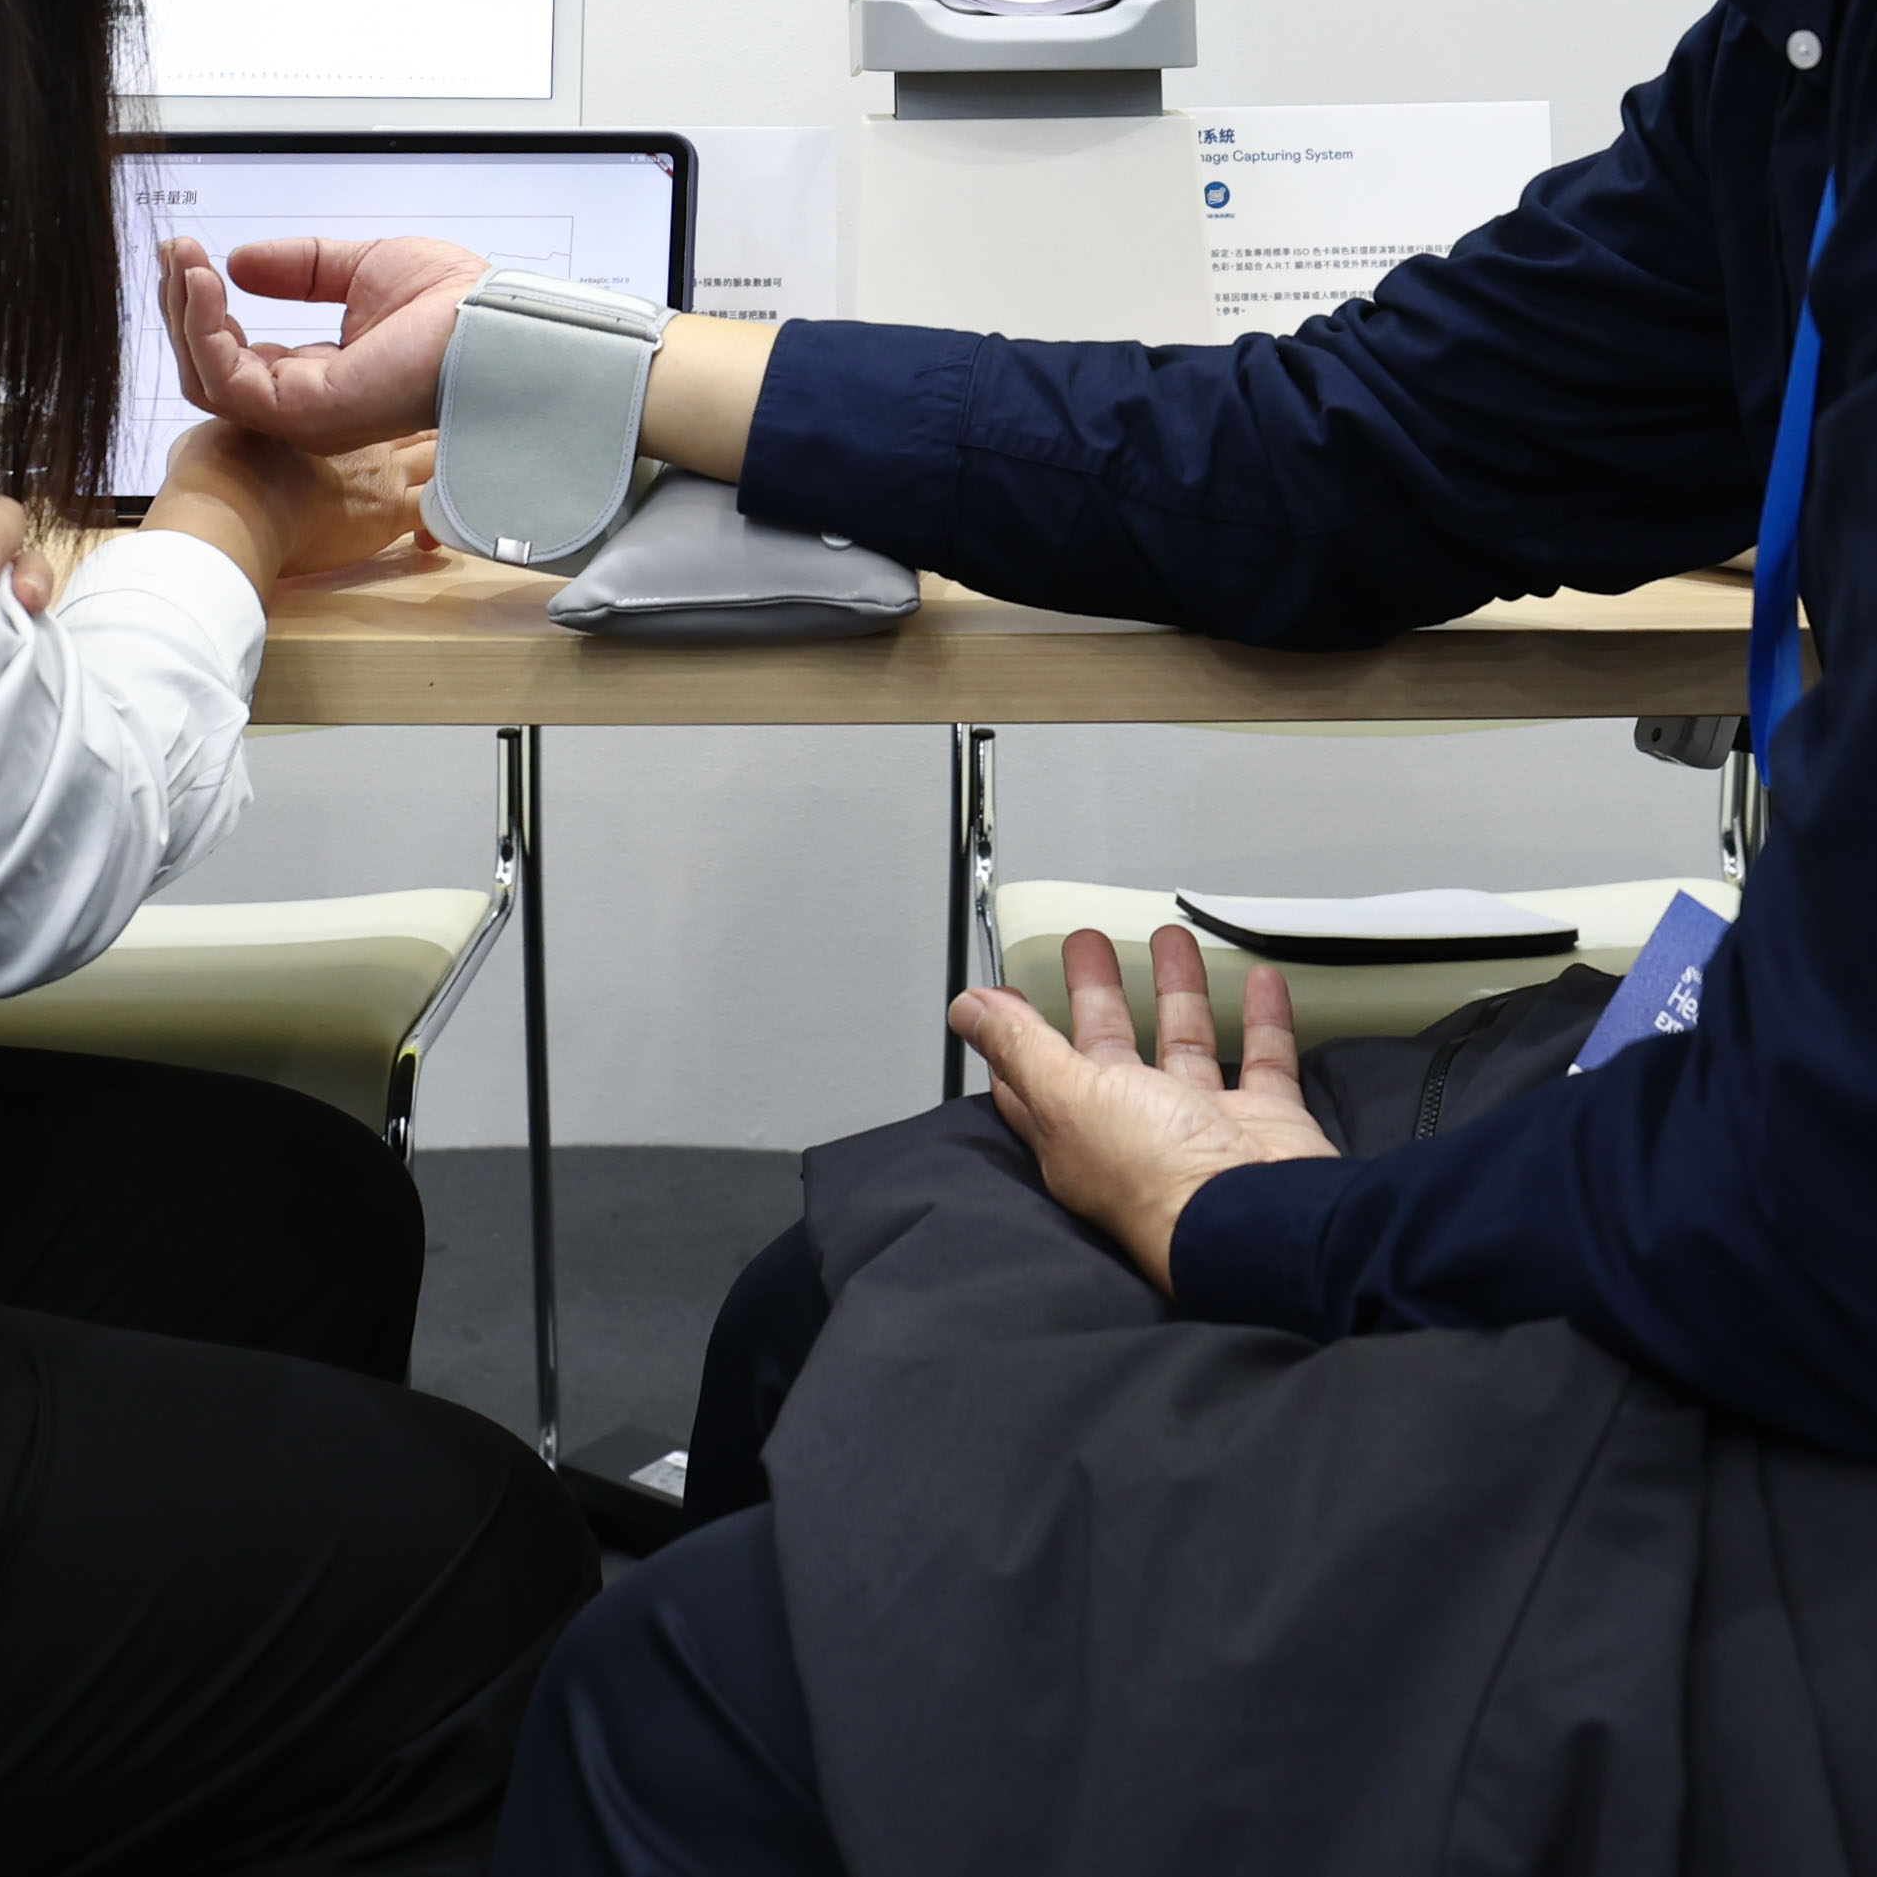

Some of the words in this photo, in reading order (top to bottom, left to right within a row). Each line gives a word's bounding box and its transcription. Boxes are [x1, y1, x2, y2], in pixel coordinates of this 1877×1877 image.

[1198, 127, 1236, 144] 系統
[1232, 148, 1302, 164] Capturing
[1305, 147, 1354, 163] System
[134, 189, 198, 205] 右手量測
[1293, 247, 1310, 257] ISO
